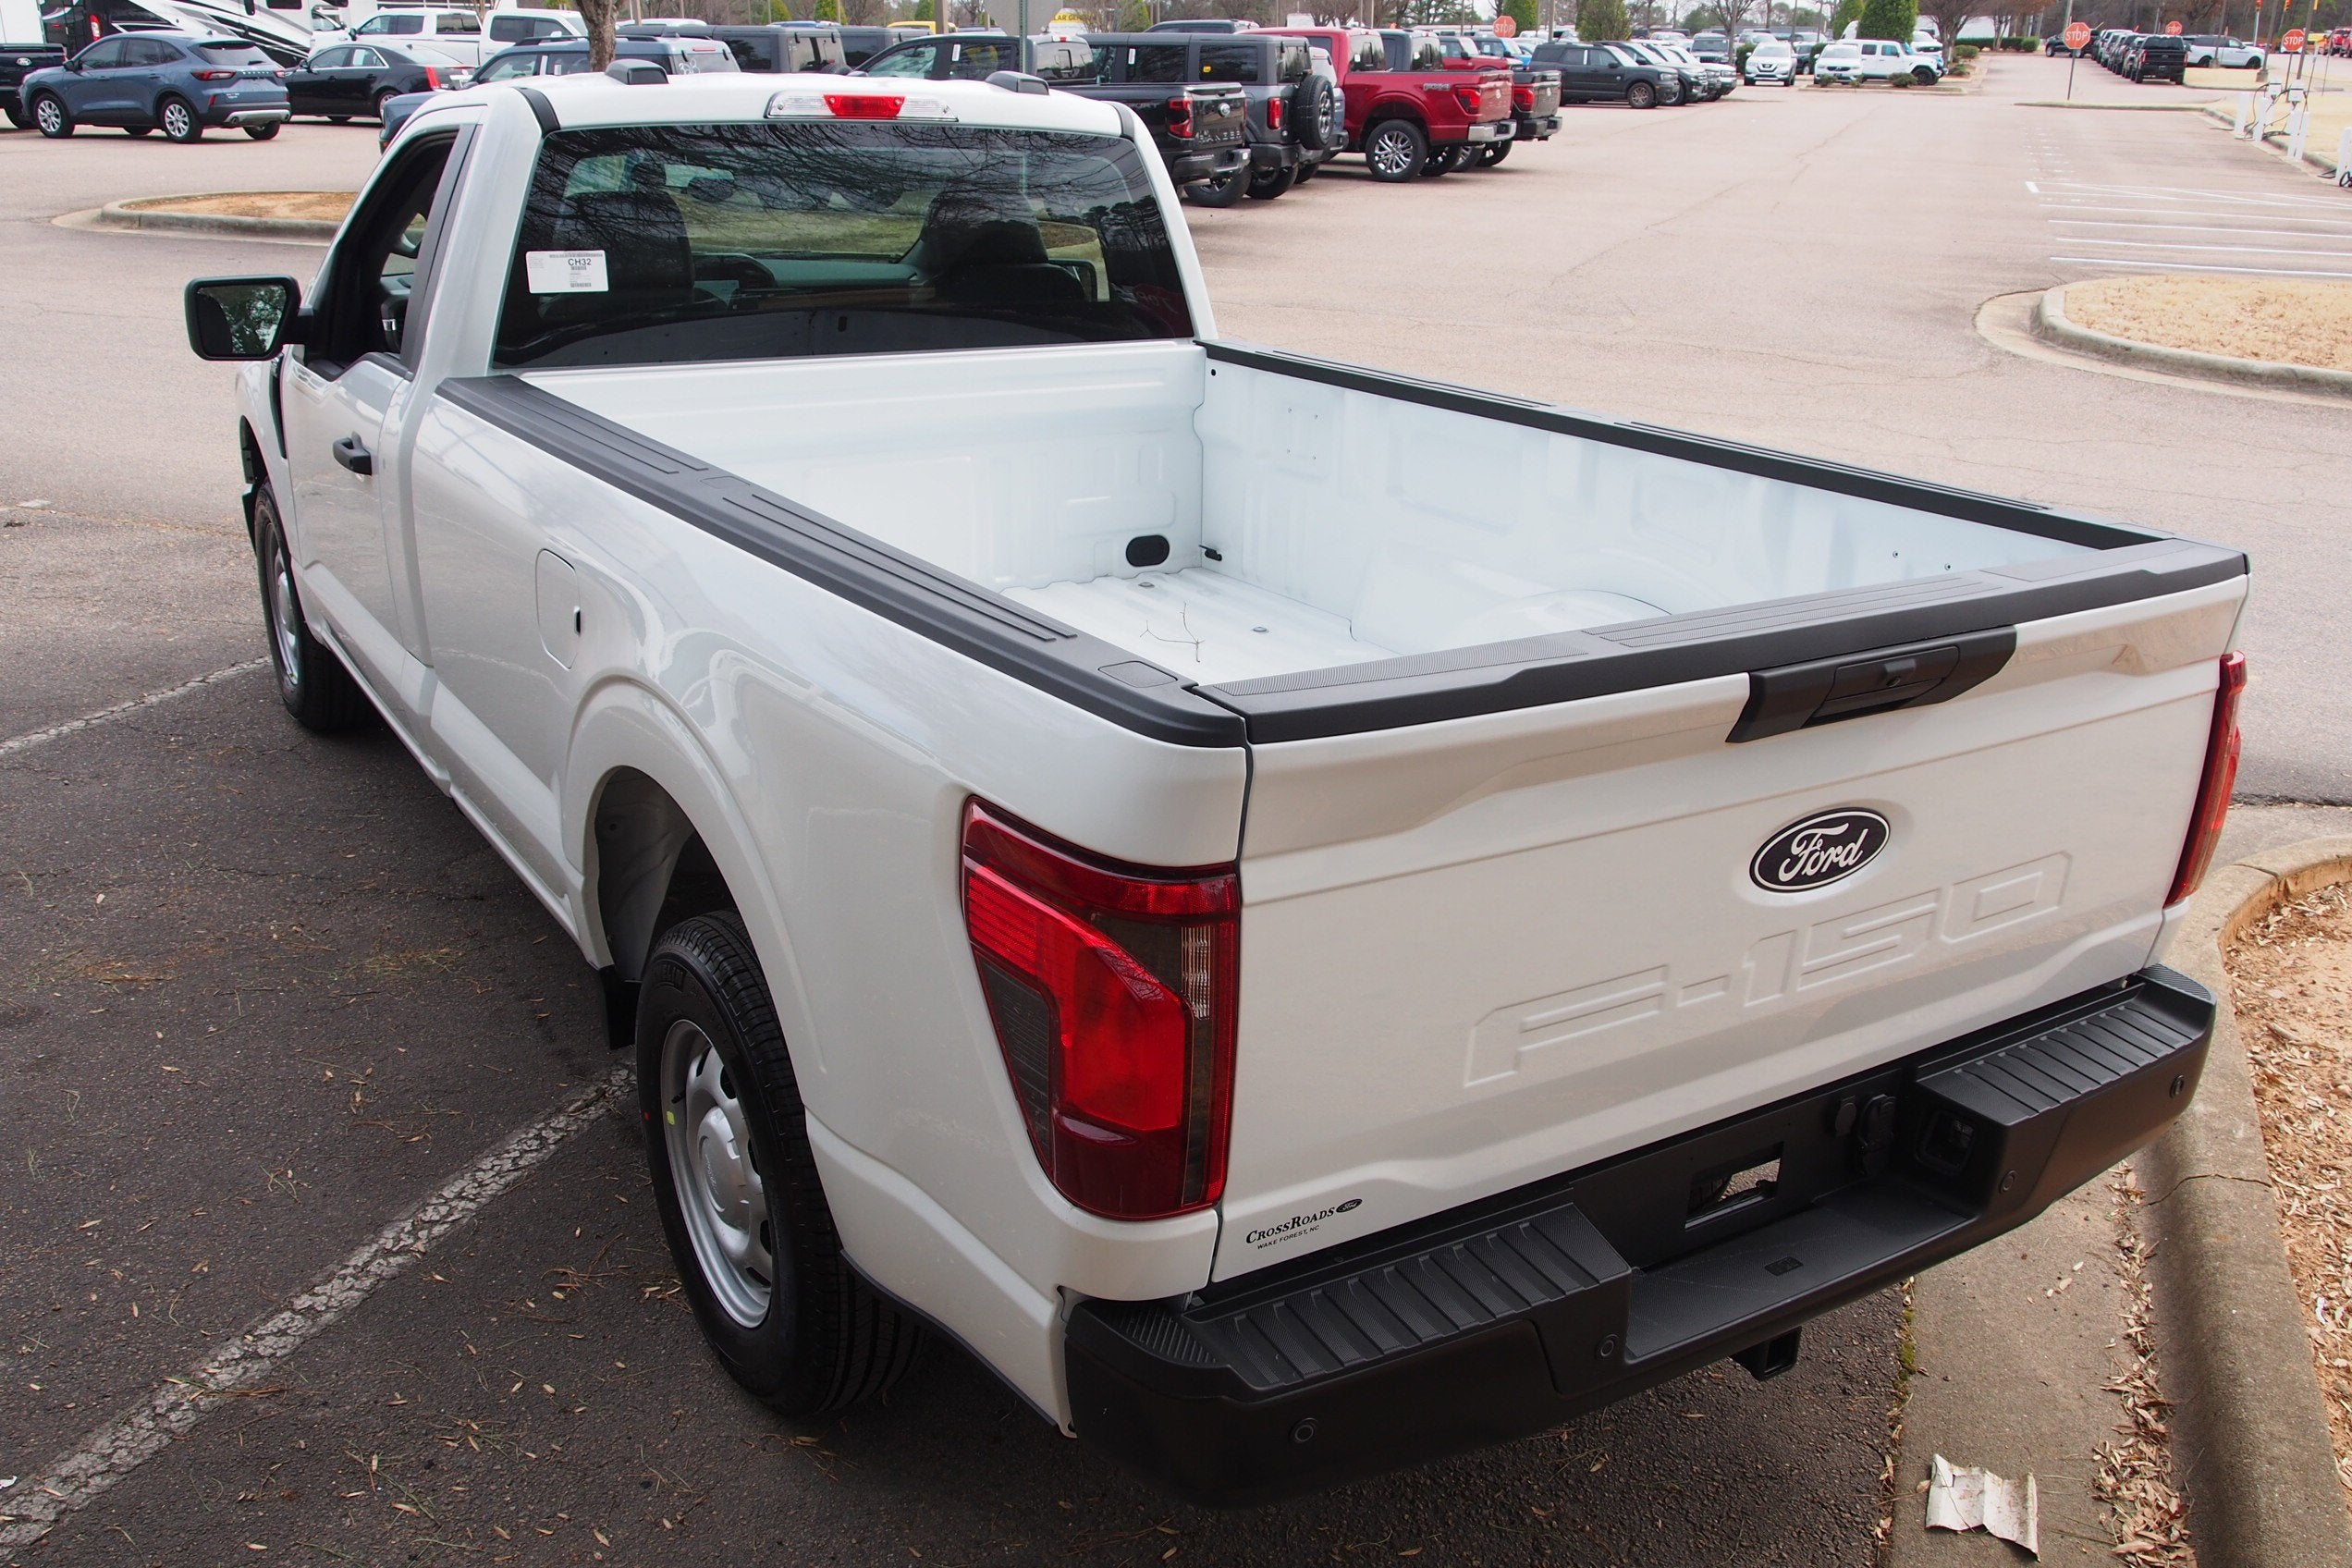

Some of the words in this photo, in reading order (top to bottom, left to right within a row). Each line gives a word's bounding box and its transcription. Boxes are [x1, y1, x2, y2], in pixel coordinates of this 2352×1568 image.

[1495, 23, 1514, 33] STOP
[2065, 31, 2089, 42] STOP
[2284, 36, 2304, 45] STOP
[568, 258, 592, 266] CH32
[1777, 821, 1869, 883] Ford
[1464, 851, 2073, 1088] F-150
[1257, 1239, 1278, 1250] WAKE
[1309, 1224, 1320, 1234] NC
